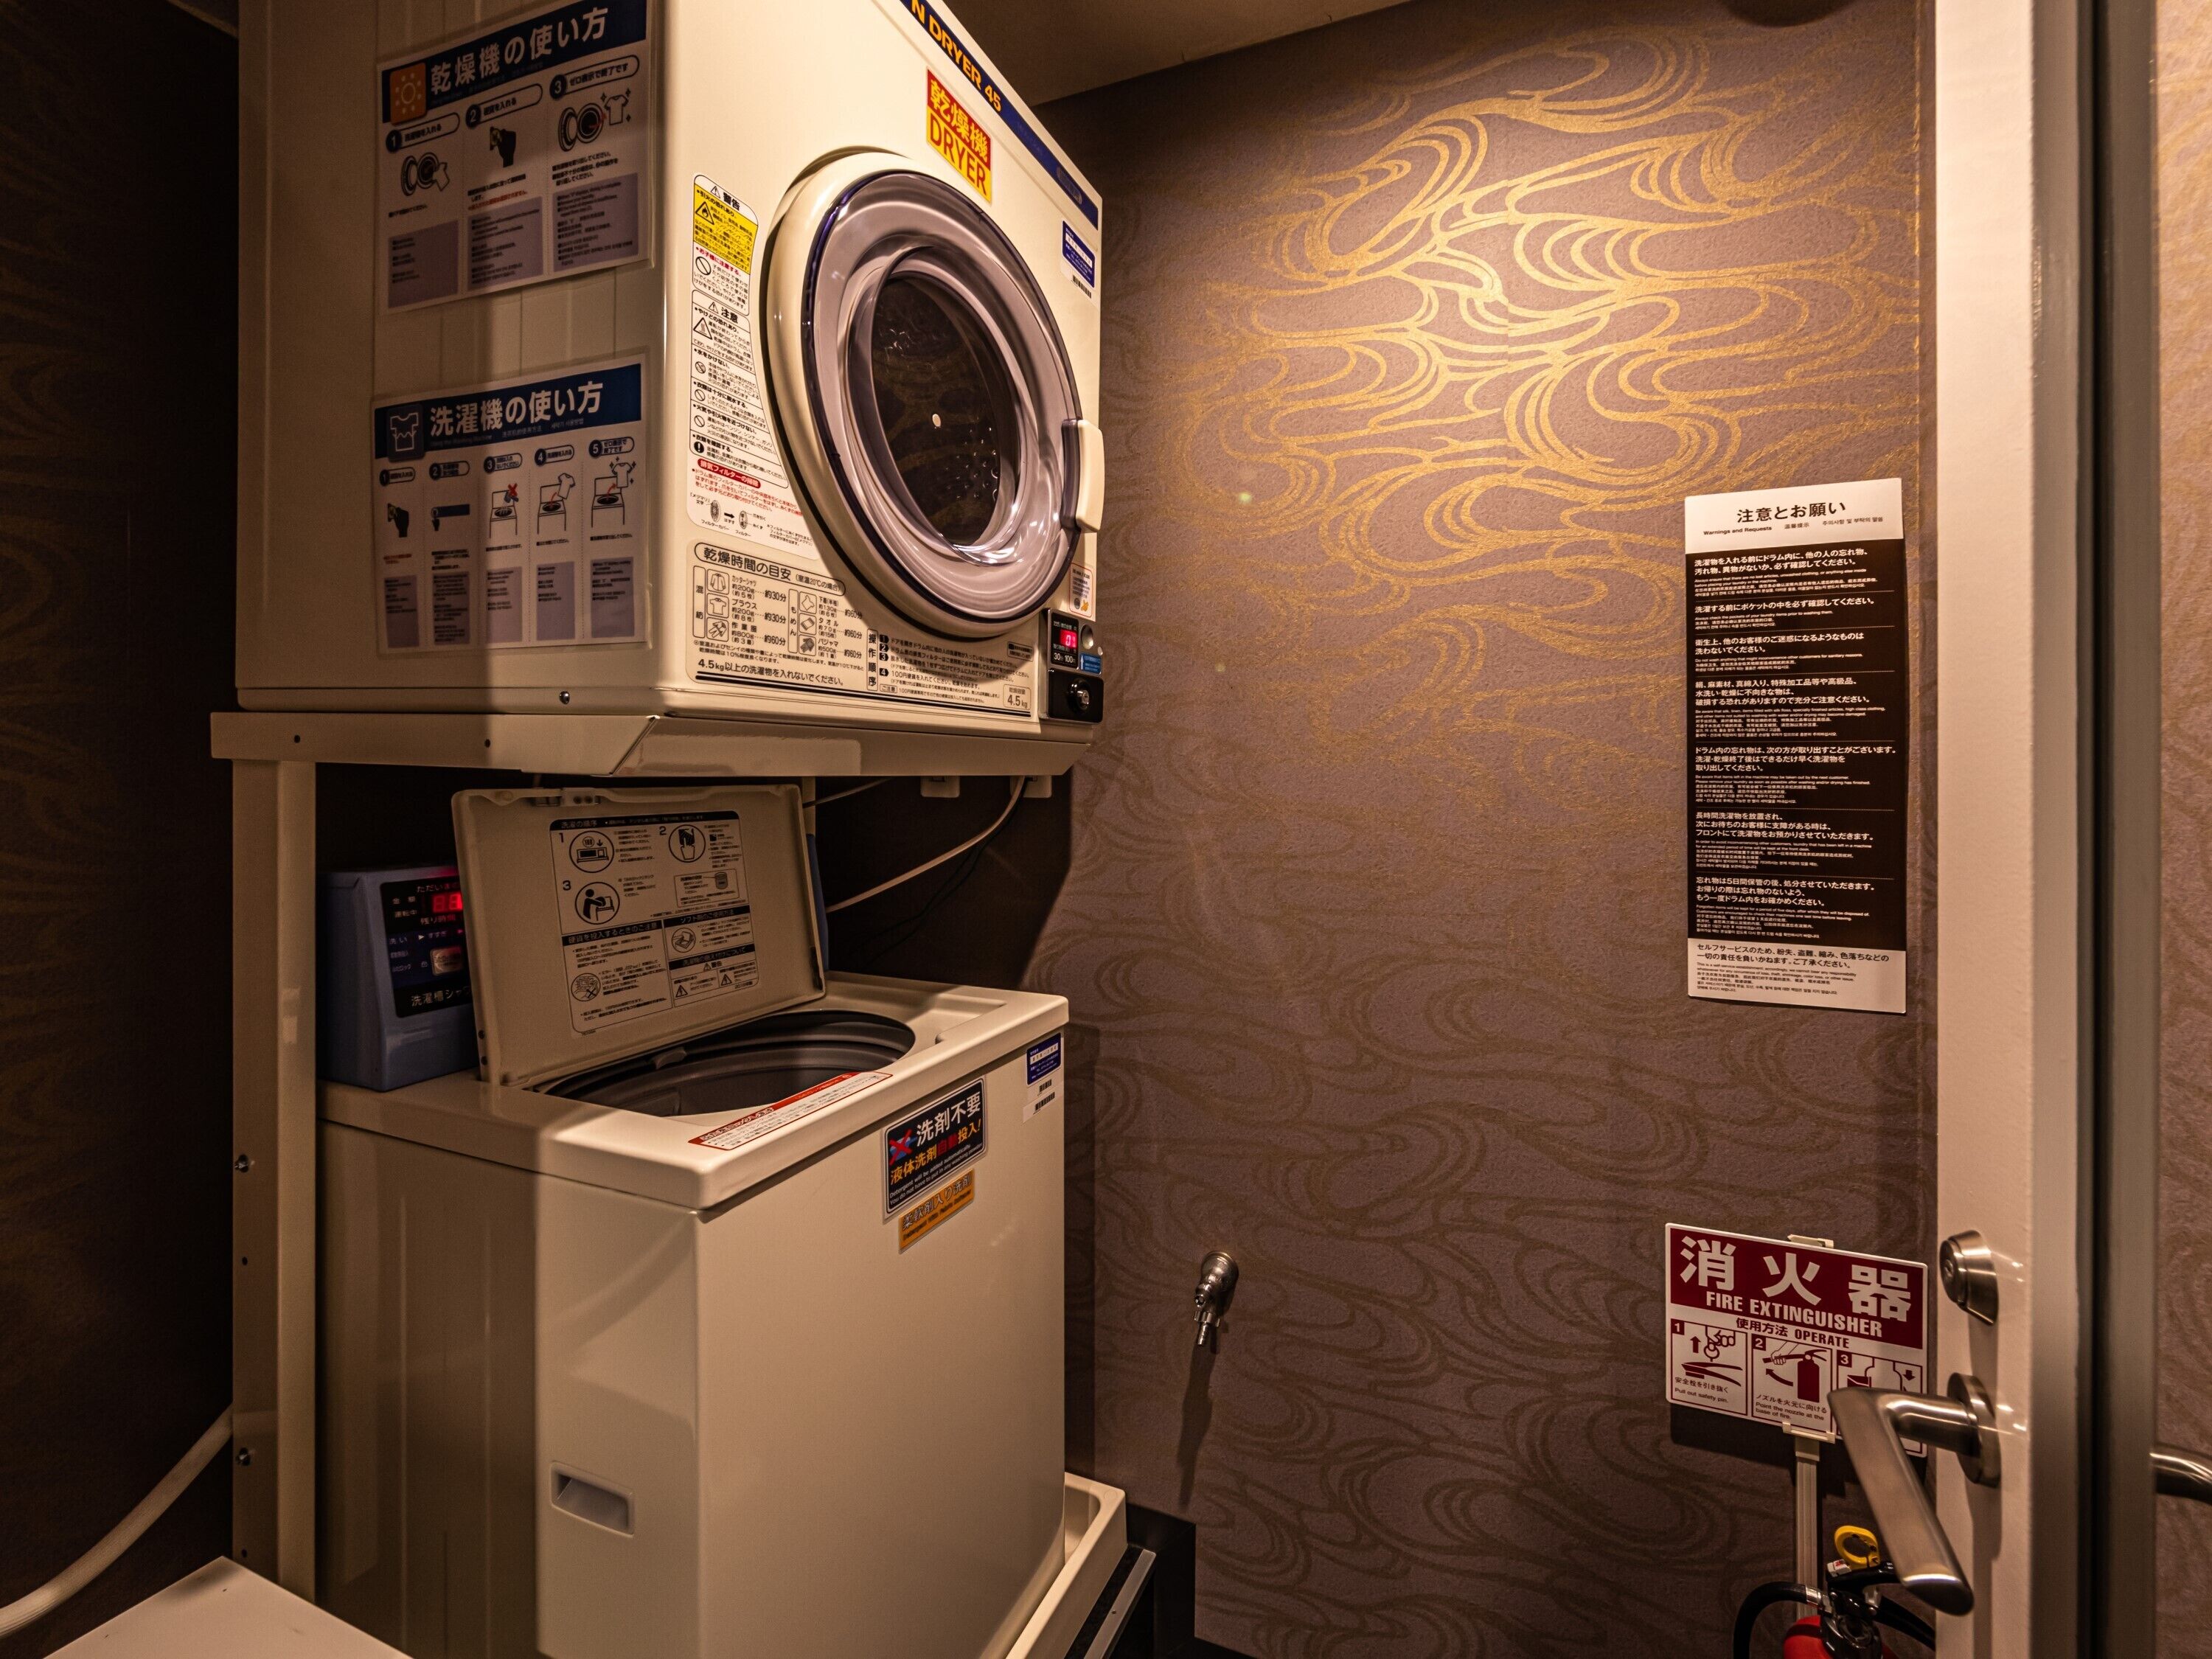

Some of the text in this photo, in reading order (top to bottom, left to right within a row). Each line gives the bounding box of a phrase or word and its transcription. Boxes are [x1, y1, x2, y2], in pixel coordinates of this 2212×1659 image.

[431, 7, 608, 95] 乾燥機の使い方
[930, 17, 981, 90] DRYER
[984, 85, 1001, 112] 45
[930, 78, 989, 164] 乾燥機
[930, 114, 987, 195] DRYER
[721, 307, 738, 324] 注意
[431, 381, 603, 437] 洗濯機の使い方
[592, 443, 599, 453] 5
[487, 459, 493, 469] 3
[538, 453, 543, 462] 4
[432, 467, 439, 476] 2
[1737, 502, 1846, 523] 注意とお願い
[1703, 527, 1731, 535] Warnings
[703, 547, 791, 581] 乾燥時間の目安
[1694, 548, 1868, 567] 洗濯物を入れる前にドラム内に、他の人の忘れ物、
[1694, 558, 1857, 575] 汚れ物、異物がないか、必ず確認してください。
[765, 590, 786, 602] 約30分
[731, 599, 757, 610] ブラウス
[1694, 597, 1875, 613] 洗濯する前にポケットの中を必ず確認してください。
[764, 613, 786, 624] 約30分
[1695, 633, 1864, 646] 衛生上、他のお客様のご迷惑になるようなものは
[1695, 646, 1766, 655] 洗わないでください。
[868, 633, 876, 686] 操作順序
[698, 658, 844, 686] 4.5kg以上の洗濯物を入れないでください。
[1007, 695, 1028, 709] 4.5 kg
[1695, 696, 1870, 706] 破損する恐れがありますので充分ご注意ください。
[1695, 746, 1896, 754] ドラム内の忘れ物は、次の方が取り出すことがございます。
[1696, 812, 1783, 821] 長時間洗濯物を放置され、
[659, 827, 667, 836] 2
[1695, 821, 1832, 830] 次にお待ちのお客様に支障がある時は、
[558, 832, 565, 843] 1
[1696, 830, 1874, 841] フロントにて洗濯物をお預かりさせていただきます。
[563, 880, 572, 891] 3
[1696, 877, 1875, 891] 忘れ物は5日間保管の後、処分させていただきます。
[1696, 886, 1806, 897] お帰りの際は忘れ物のないよう、
[1696, 894, 1825, 906] もう一度ドラム内をお確かめください。
[1697, 944, 1889, 962] セルフサービスのため、紛失、盗難、縮み、色落ちなどの
[1697, 952, 1851, 969] 一切の責任を負いかねます。ご了承ください。
[916, 1091, 981, 1147] 洗剤不要
[889, 1179, 913, 1199] Detergent
[914, 1174, 922, 1184] will
[923, 1169, 929, 1178] be
[890, 1194, 899, 1204] You
[900, 1190, 905, 1198] do
[914, 1180, 926, 1192] have
[931, 1170, 939, 1181] put
[903, 1175, 971, 1230] 柔軟剤入り洗剤
[1680, 1236, 1911, 1322] 消火器
[1706, 1291, 1882, 1338] FIRE EXTINGUISHER
[1674, 1323, 1681, 1332] 1
[1736, 1318, 1849, 1349] 使用方法 OPERATE
[1754, 1338, 1763, 1348] 2
[1840, 1354, 1848, 1365] 3
[1675, 1377, 1728, 1394] 安全栓を引き抜く
[1698, 1392, 1716, 1402] safety
[1756, 1394, 1826, 1413] ノズルを火元に向ける
[1756, 1402, 1772, 1410] Point
[1784, 1408, 1804, 1416] nozzle
